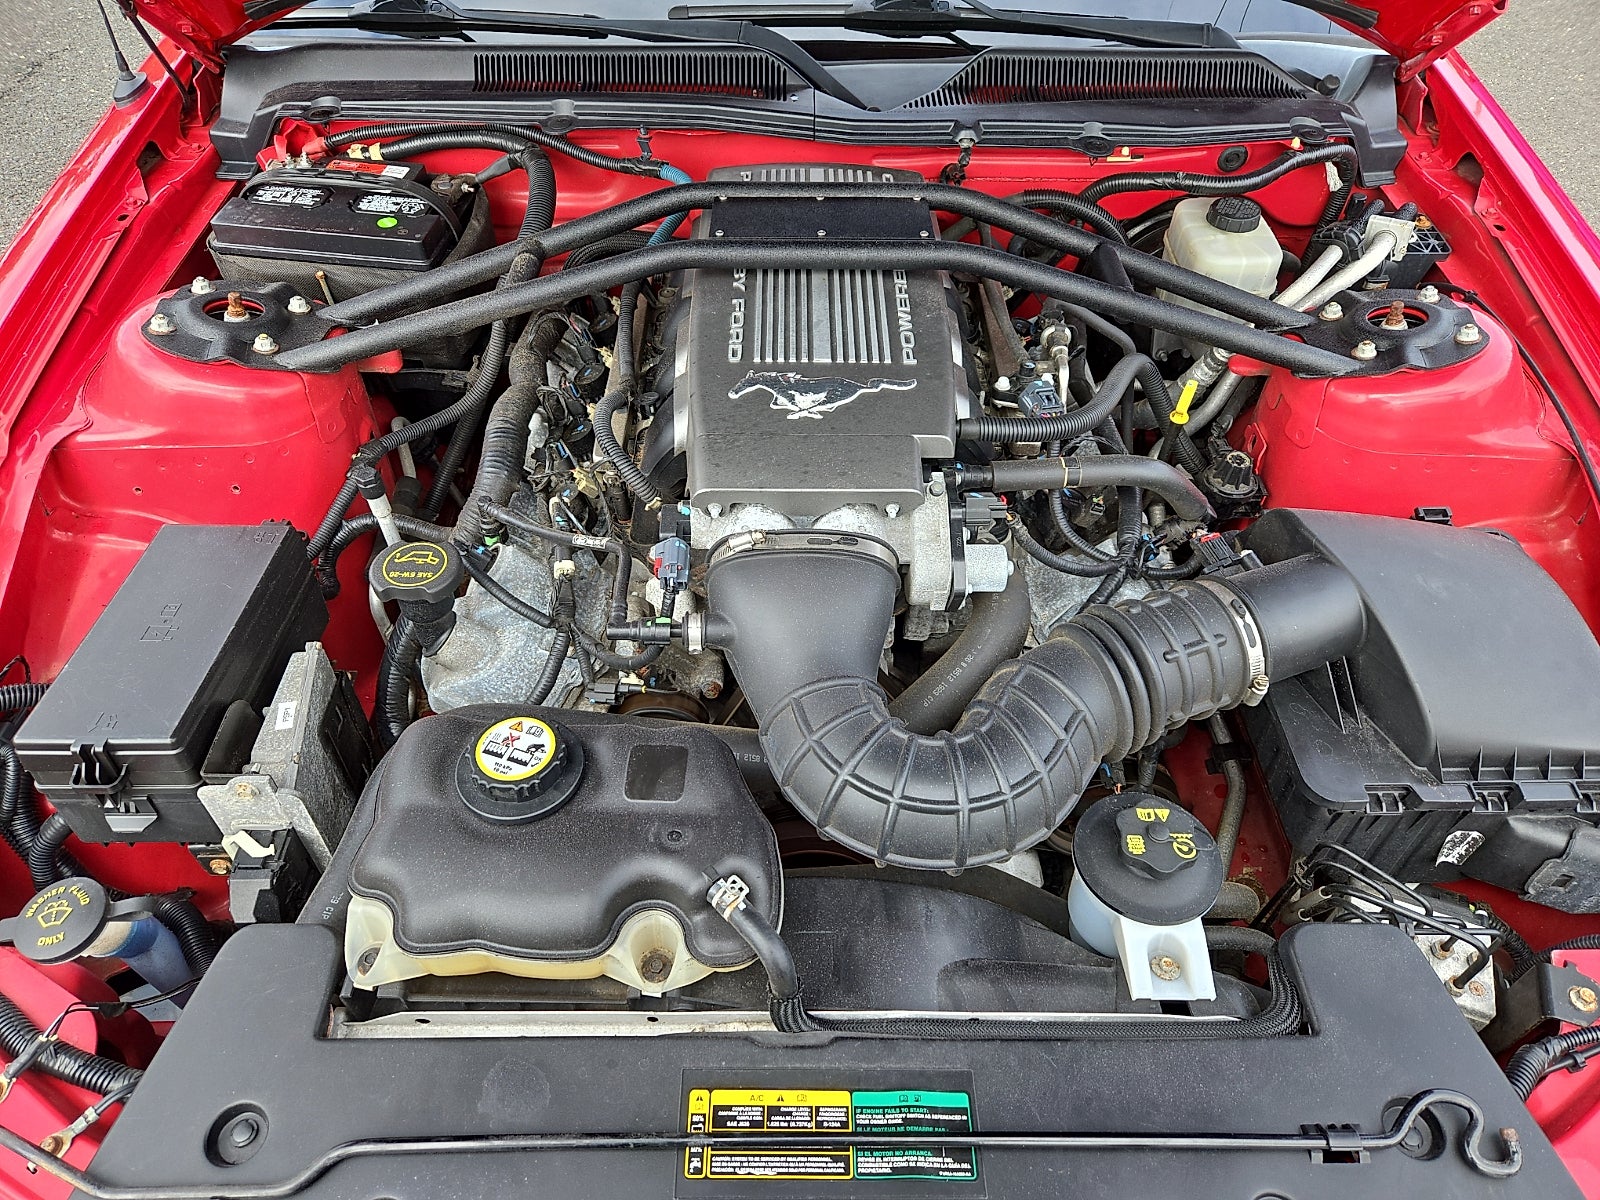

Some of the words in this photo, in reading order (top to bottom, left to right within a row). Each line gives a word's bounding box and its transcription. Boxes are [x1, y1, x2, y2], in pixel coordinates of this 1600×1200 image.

[732, 268, 746, 293] BY
[728, 298, 745, 363] FORD
[893, 269, 918, 364] POWERE
[25, 886, 66, 918] WASHER
[68, 885, 91, 906] FLUID
[37, 931, 66, 946] ONLY
[750, 1094, 764, 1102] A/C
